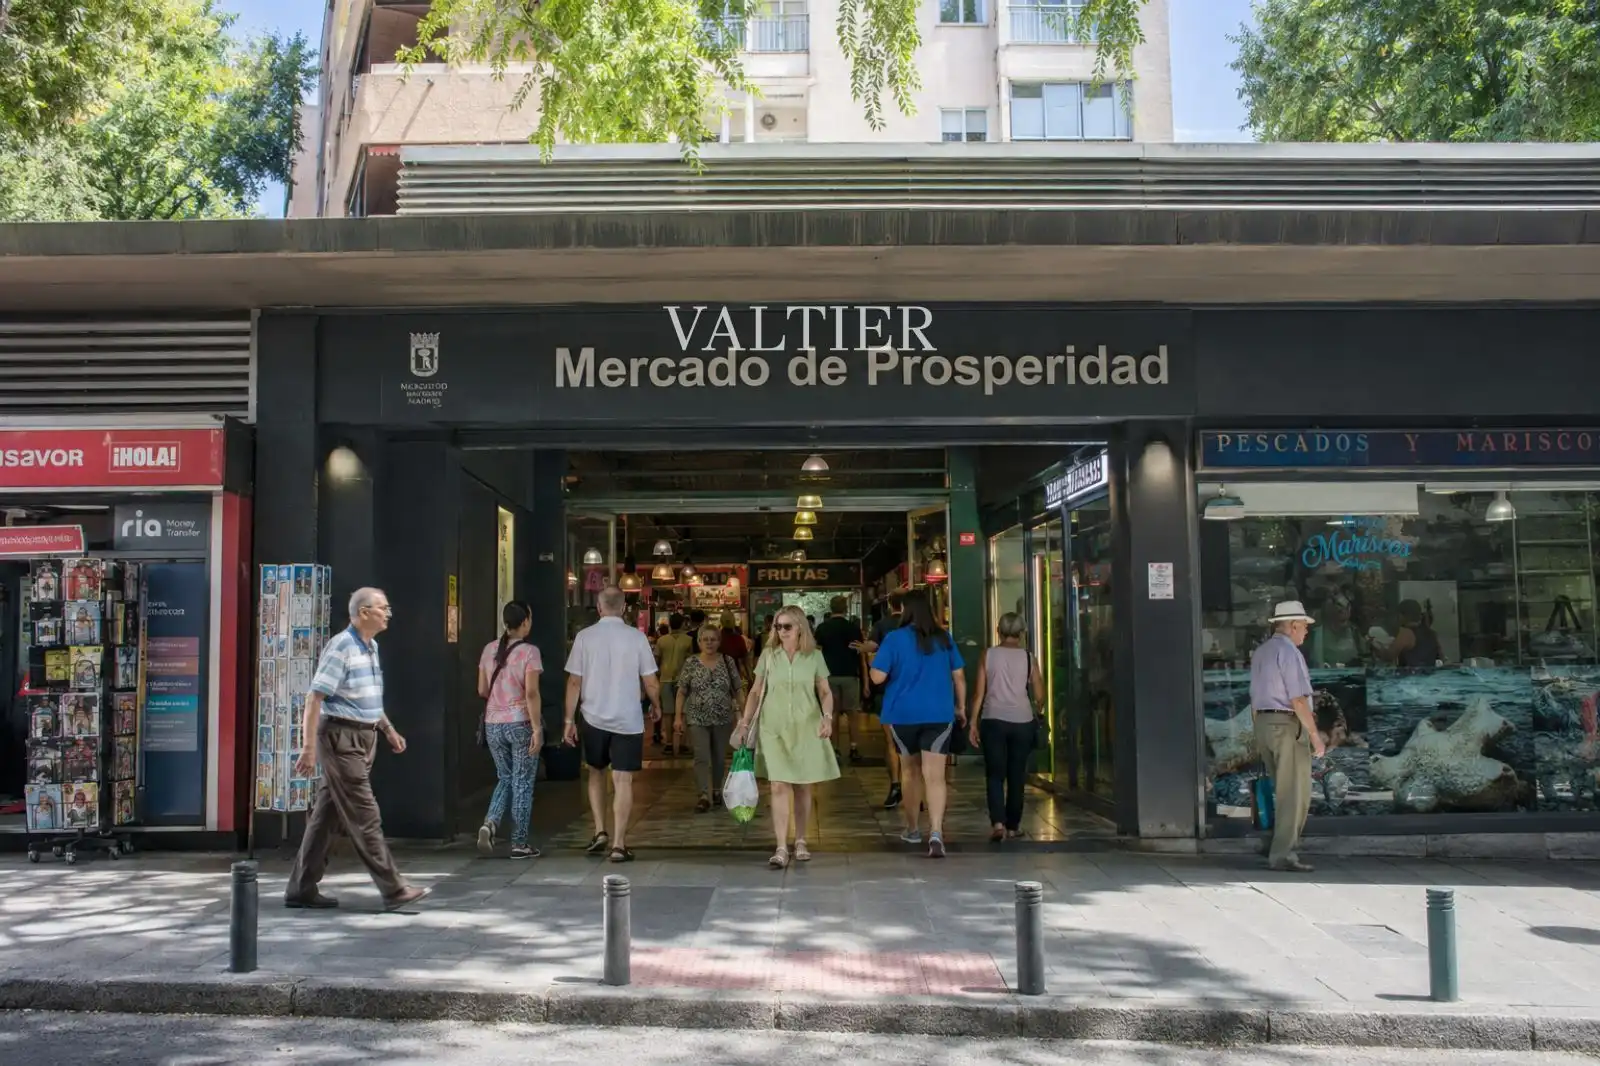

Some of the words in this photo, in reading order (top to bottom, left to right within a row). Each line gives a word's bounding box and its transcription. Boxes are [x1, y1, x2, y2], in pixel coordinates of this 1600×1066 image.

[555, 346, 770, 388] Mercado
[787, 345, 847, 386] de
[867, 344, 1169, 395] Prosperidad
[1217, 433, 1369, 452] PESCADOS
[1405, 433, 1420, 451] Y
[1456, 432, 1600, 452] MARISCO
[112, 446, 177, 467] ¡HOLA!
[121, 509, 162, 537] ria
[166, 519, 196, 529] Money
[757, 565, 829, 581] FRUTAS
